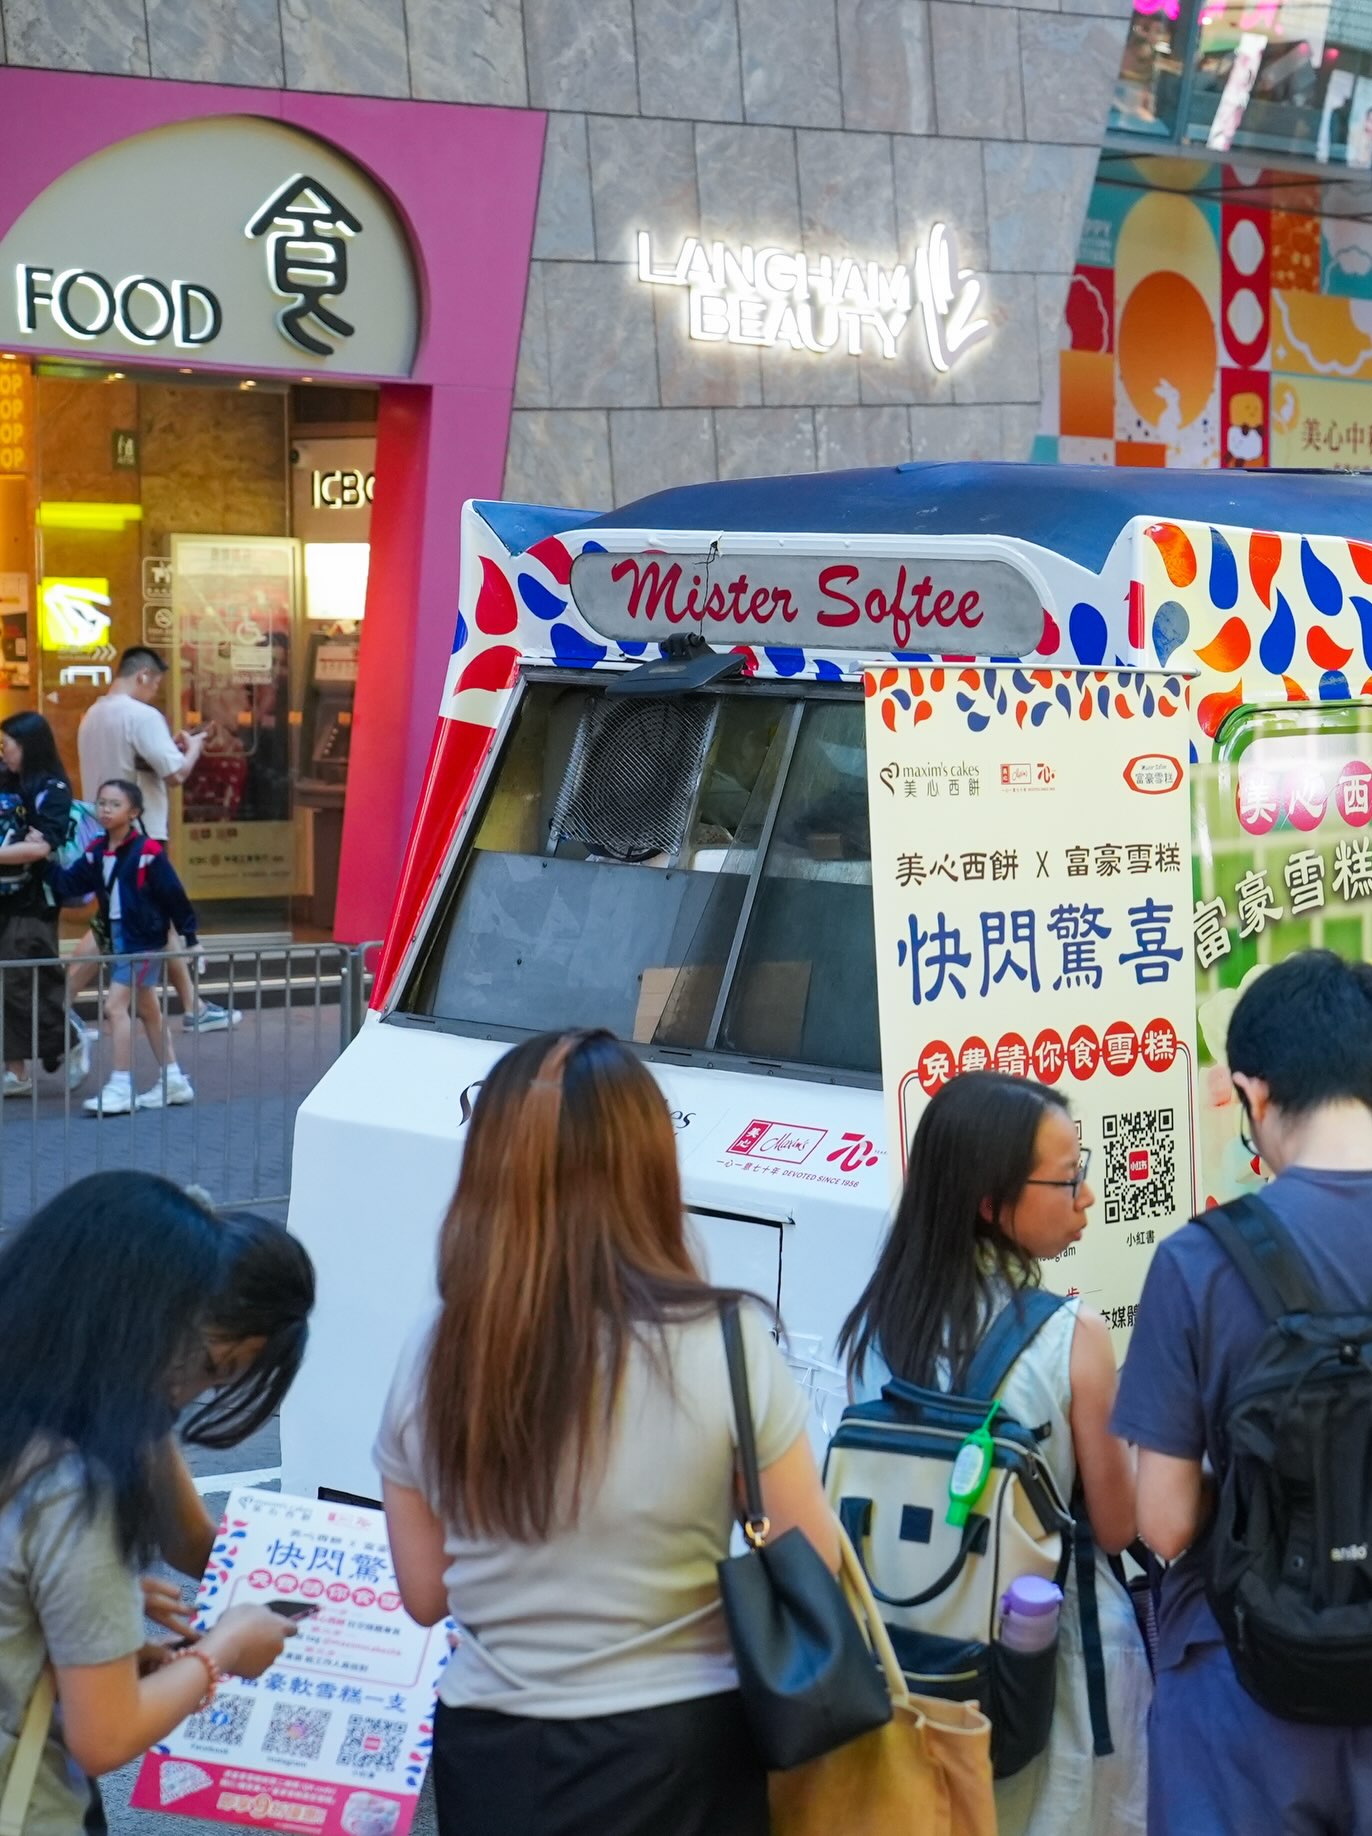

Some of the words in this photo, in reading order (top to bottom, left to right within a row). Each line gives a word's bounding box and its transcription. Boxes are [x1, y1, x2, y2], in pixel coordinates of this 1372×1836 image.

[244, 173, 362, 356] 食
[637, 231, 911, 310] LANGHAM
[16, 264, 222, 348] FOOD
[689, 287, 909, 360] BEAUTY
[611, 559, 799, 624] Mister
[816, 563, 984, 649] Softee
[903, 761, 948, 777] maxim's
[951, 761, 980, 777] cakes
[895, 849, 1019, 887] 美心西餅
[1065, 841, 1181, 877] 富豪雪糕
[897, 897, 1184, 1006] 快閃驚喜
[922, 1029, 1175, 1087] 免費請你食雪糕
[782, 1170, 817, 1181] DEVOTED
[817, 1175, 841, 1185] SINCE
[842, 1179, 860, 1188] 1956
[1126, 1229, 1155, 1247] 小紅書
[267, 1538, 396, 1583] 快閃驚
